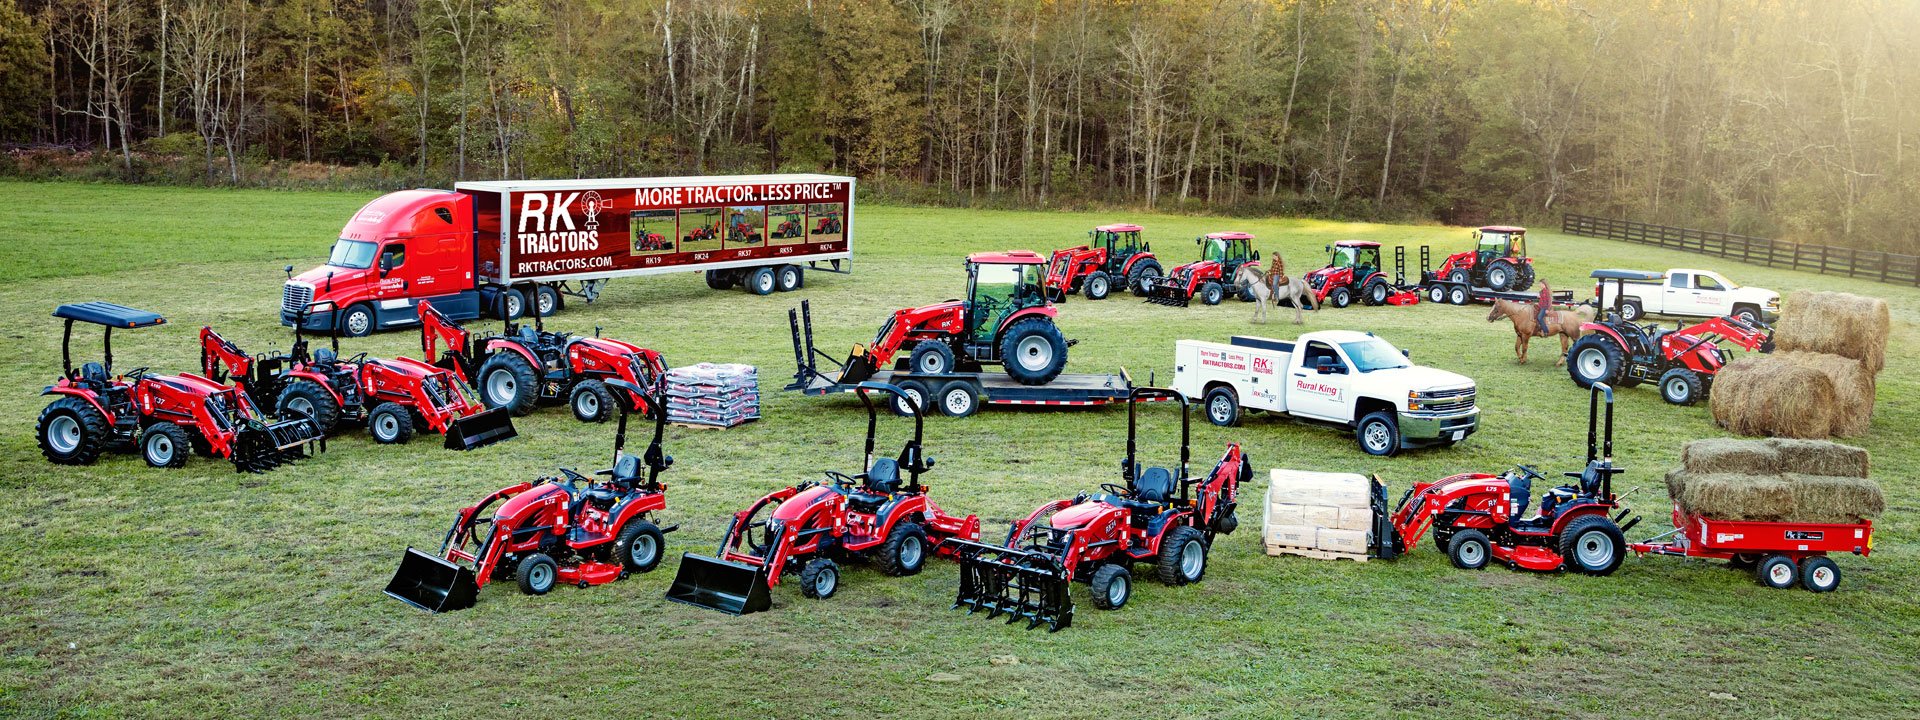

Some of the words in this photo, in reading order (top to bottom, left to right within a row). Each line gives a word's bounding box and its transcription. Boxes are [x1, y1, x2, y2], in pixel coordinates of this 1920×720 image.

[635, 187, 682, 206] MORE
[686, 185, 757, 204] TRACTOR.
[761, 184, 791, 200] LESS
[518, 192, 580, 232] RK
[518, 231, 598, 254] TRACTORS
[694, 252, 709, 260] RK24
[738, 249, 752, 257] RK37
[518, 256, 612, 273] RKTRACTORS.COM
[645, 256, 661, 264] RK19
[1202, 359, 1246, 371] RKTRACTORS.COM
[1253, 357, 1269, 369] RK
[1253, 366, 1274, 375] TRACTORS
[1296, 380, 1318, 391] Rural
[1318, 383, 1337, 396] King
